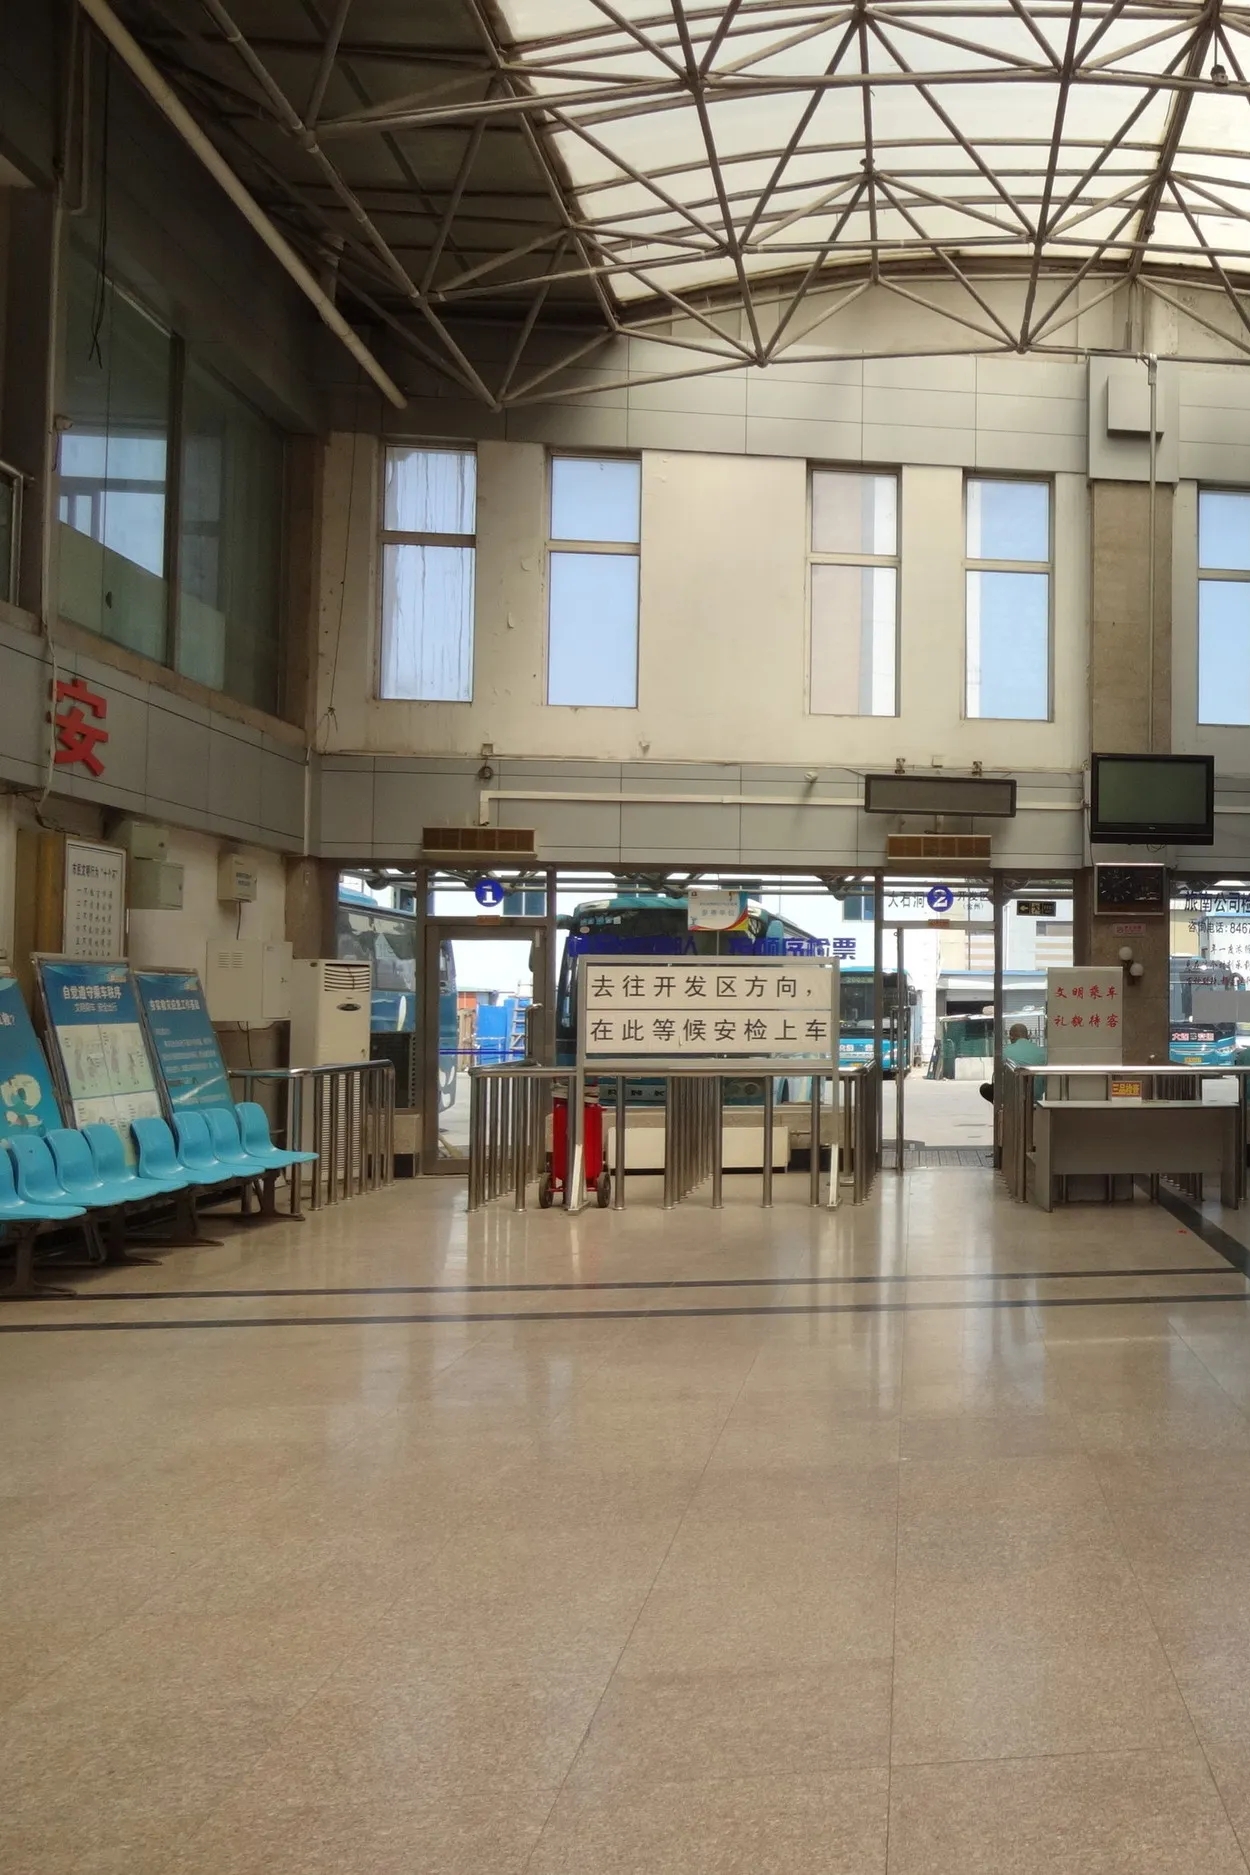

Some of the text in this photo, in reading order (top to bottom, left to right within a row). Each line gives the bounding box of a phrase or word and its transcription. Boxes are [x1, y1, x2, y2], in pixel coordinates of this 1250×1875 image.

[48, 679, 108, 776] 安
[591, 974, 813, 999] 去往开发区方向,
[1054, 984, 1118, 1000] 文明乘车
[590, 1017, 828, 1043] 在此等候安检上车
[1053, 1013, 1119, 1028] 礼貌待客
